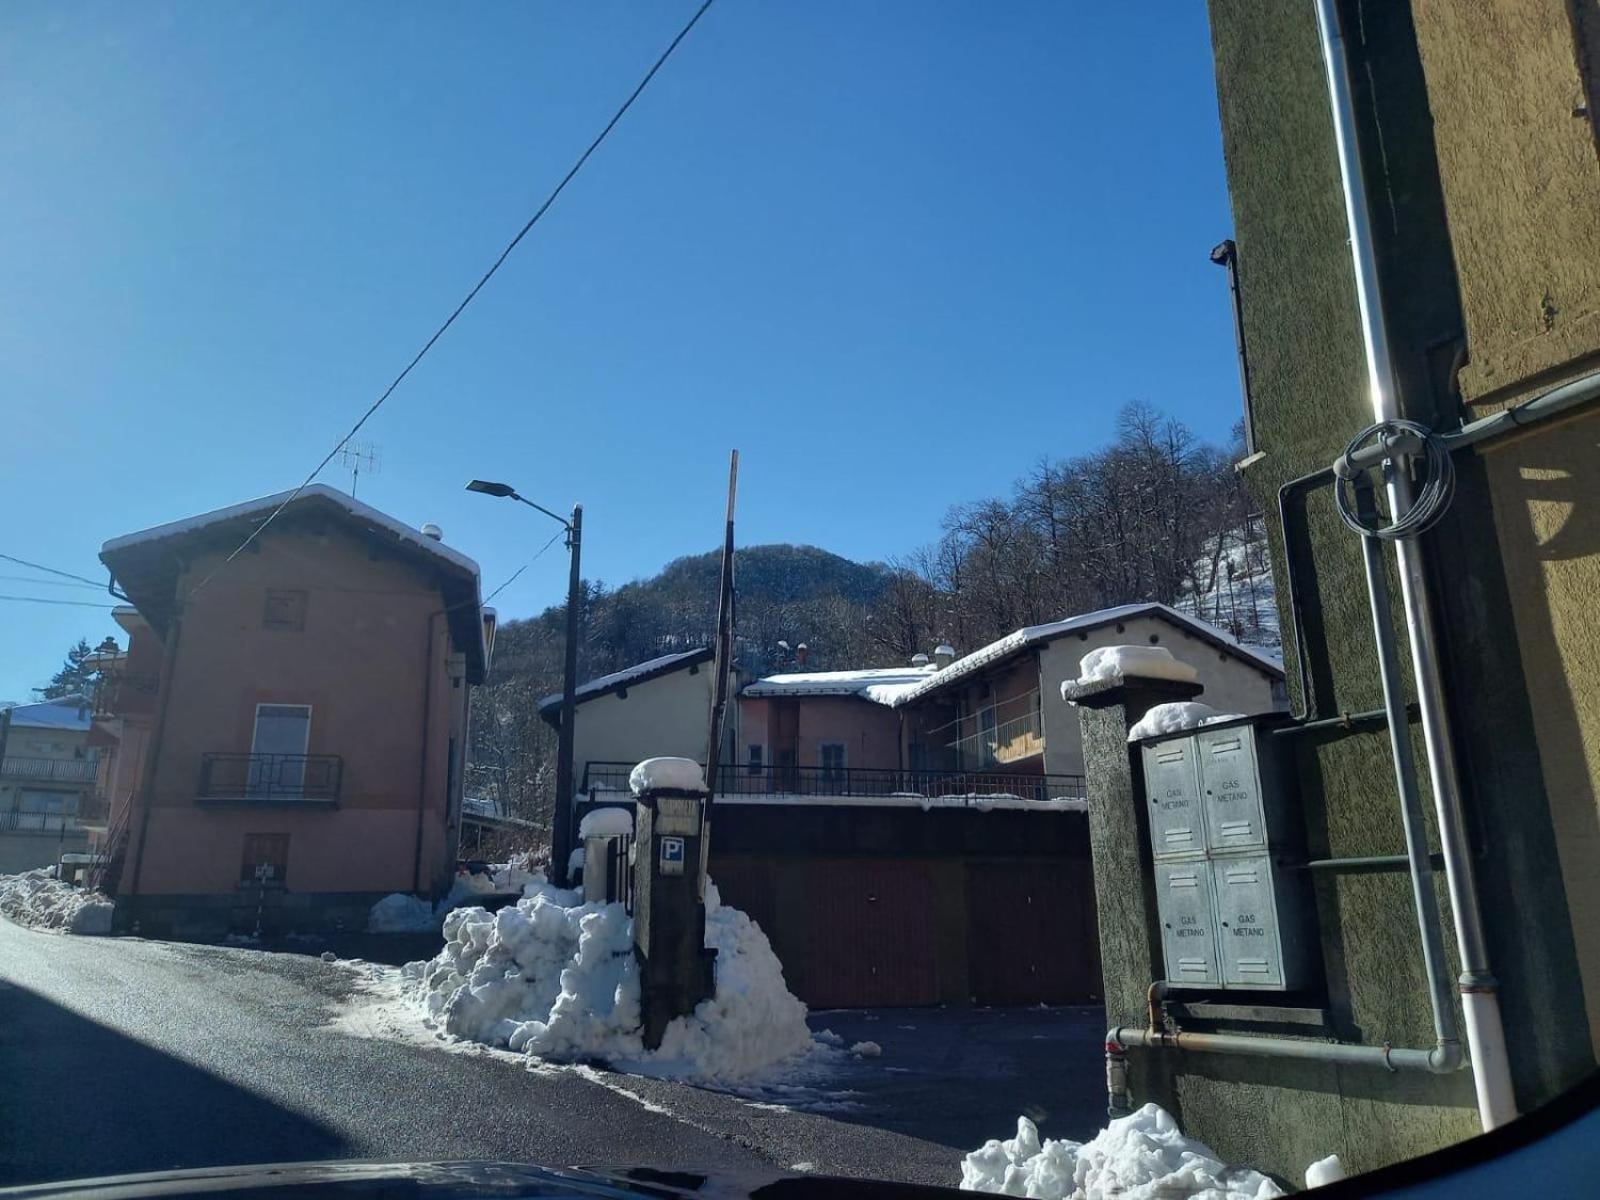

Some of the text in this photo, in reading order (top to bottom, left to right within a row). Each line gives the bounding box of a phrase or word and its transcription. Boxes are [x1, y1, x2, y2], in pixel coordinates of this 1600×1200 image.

[1222, 780, 1240, 789] GAS
[1166, 789, 1182, 798] GAS
[1217, 792, 1247, 802] METANO
[1162, 800, 1189, 810] METANO
[665, 840, 679, 859] P
[1181, 916, 1197, 925] GAS
[1238, 914, 1256, 923] GAS
[1177, 928, 1204, 937] METANO
[1233, 928, 1264, 937] METANO
